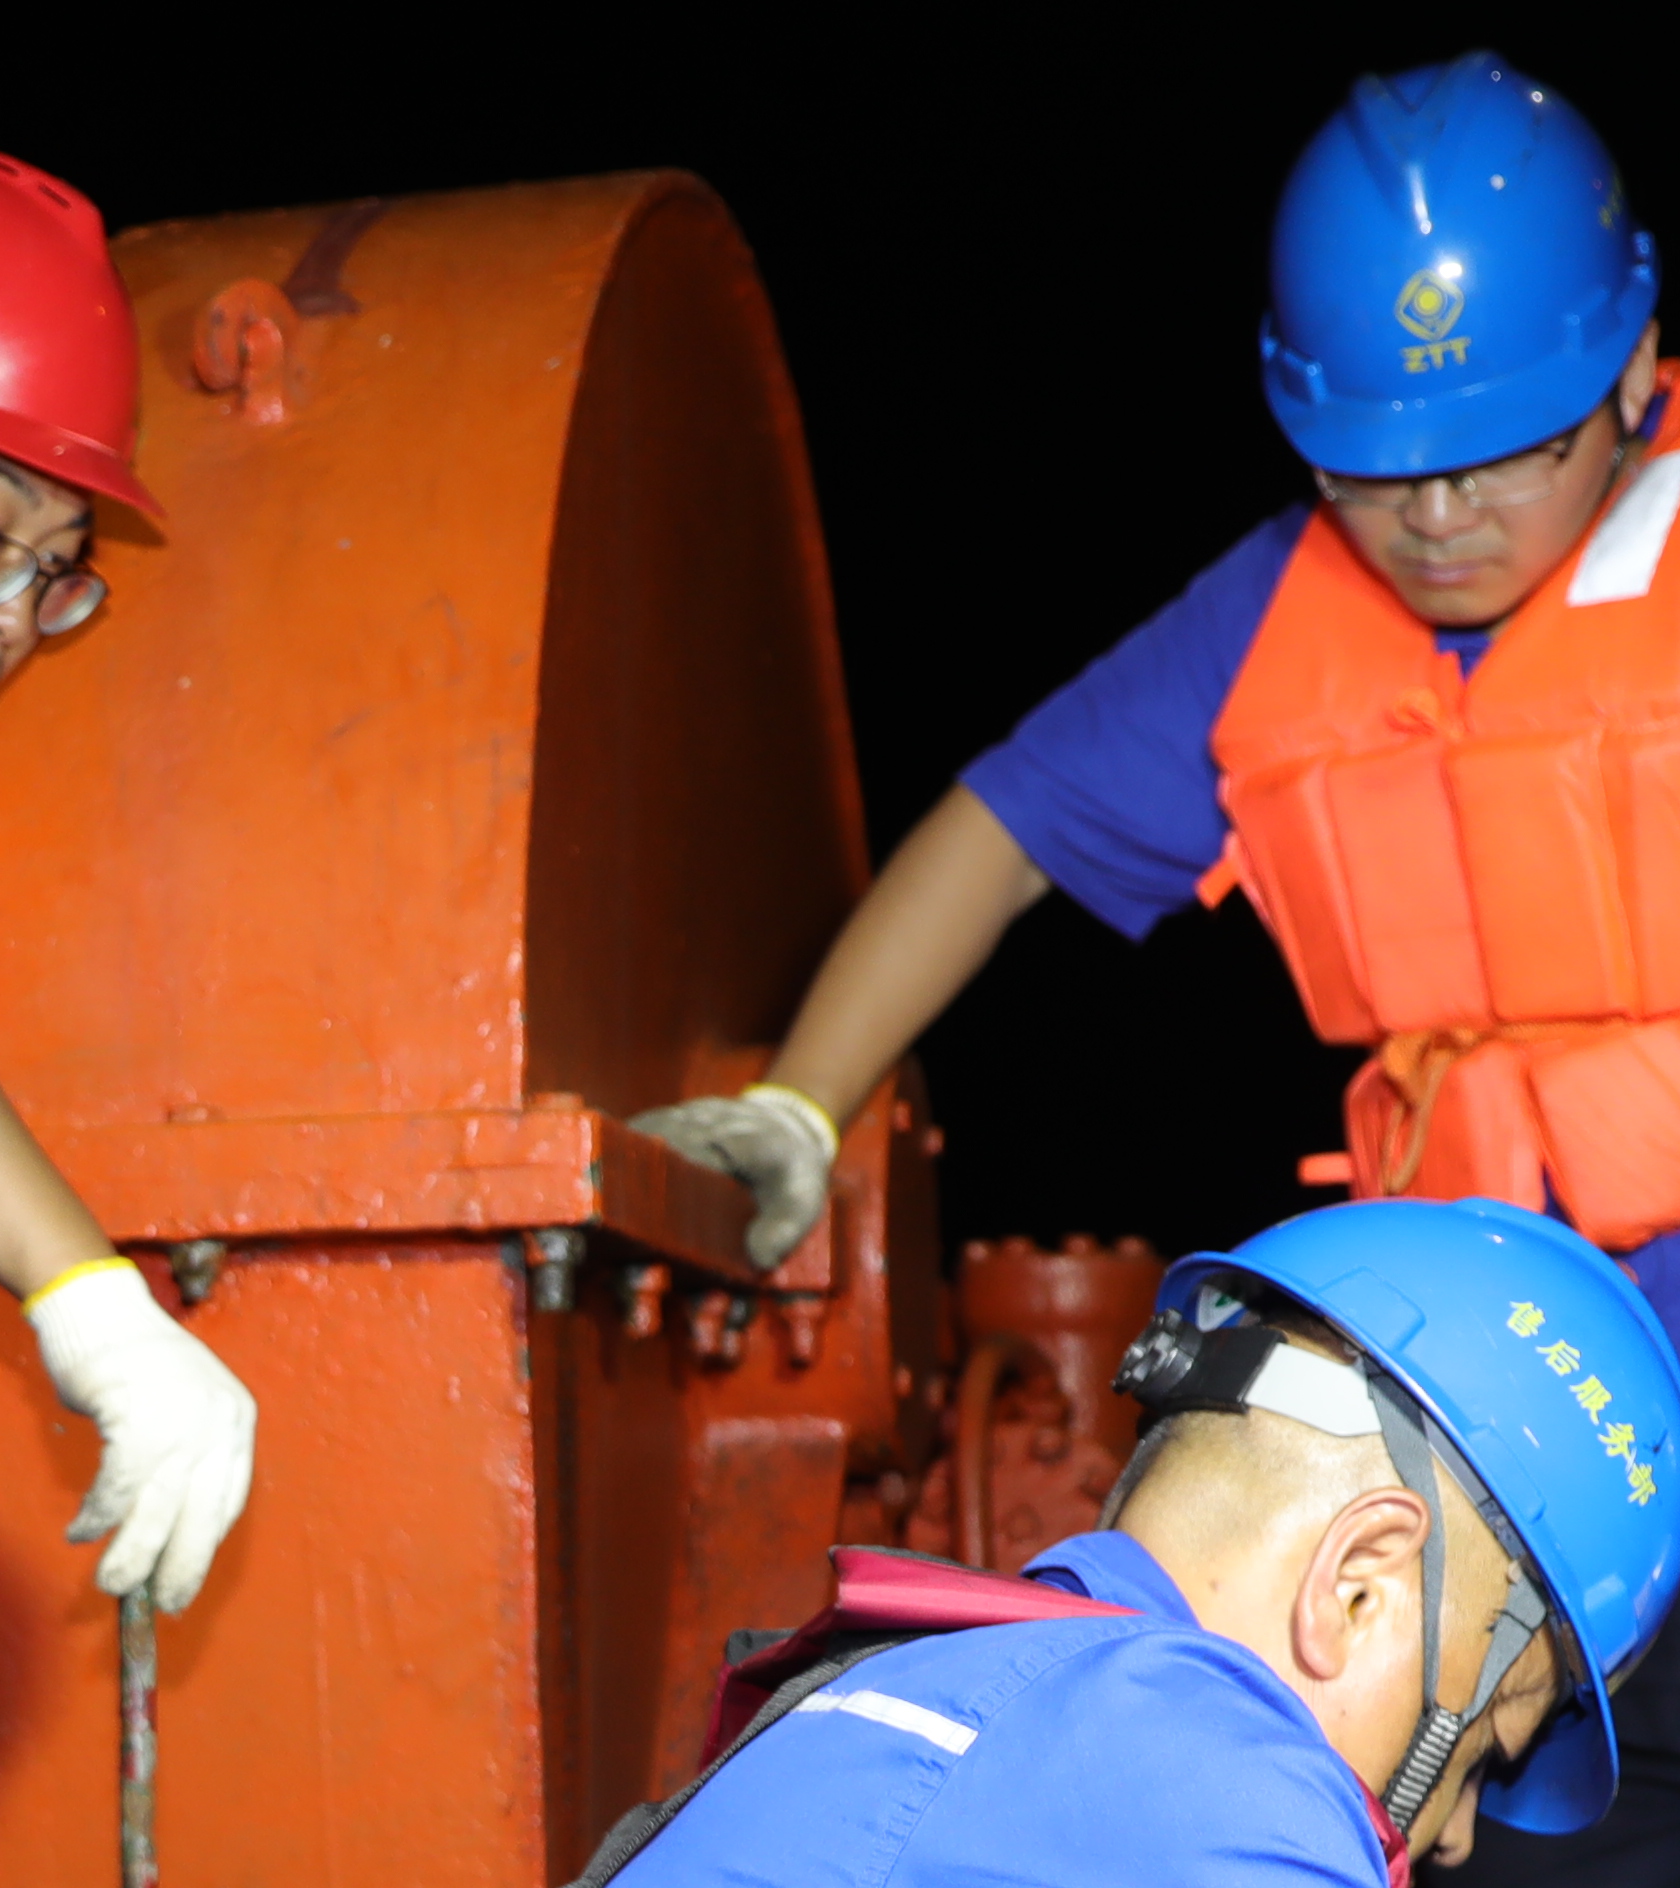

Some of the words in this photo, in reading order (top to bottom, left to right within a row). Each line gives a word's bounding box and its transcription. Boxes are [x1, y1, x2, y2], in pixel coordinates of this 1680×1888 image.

[1400, 337, 1471, 374] ZTT
[1506, 1301, 1657, 1506] 售后服务部
